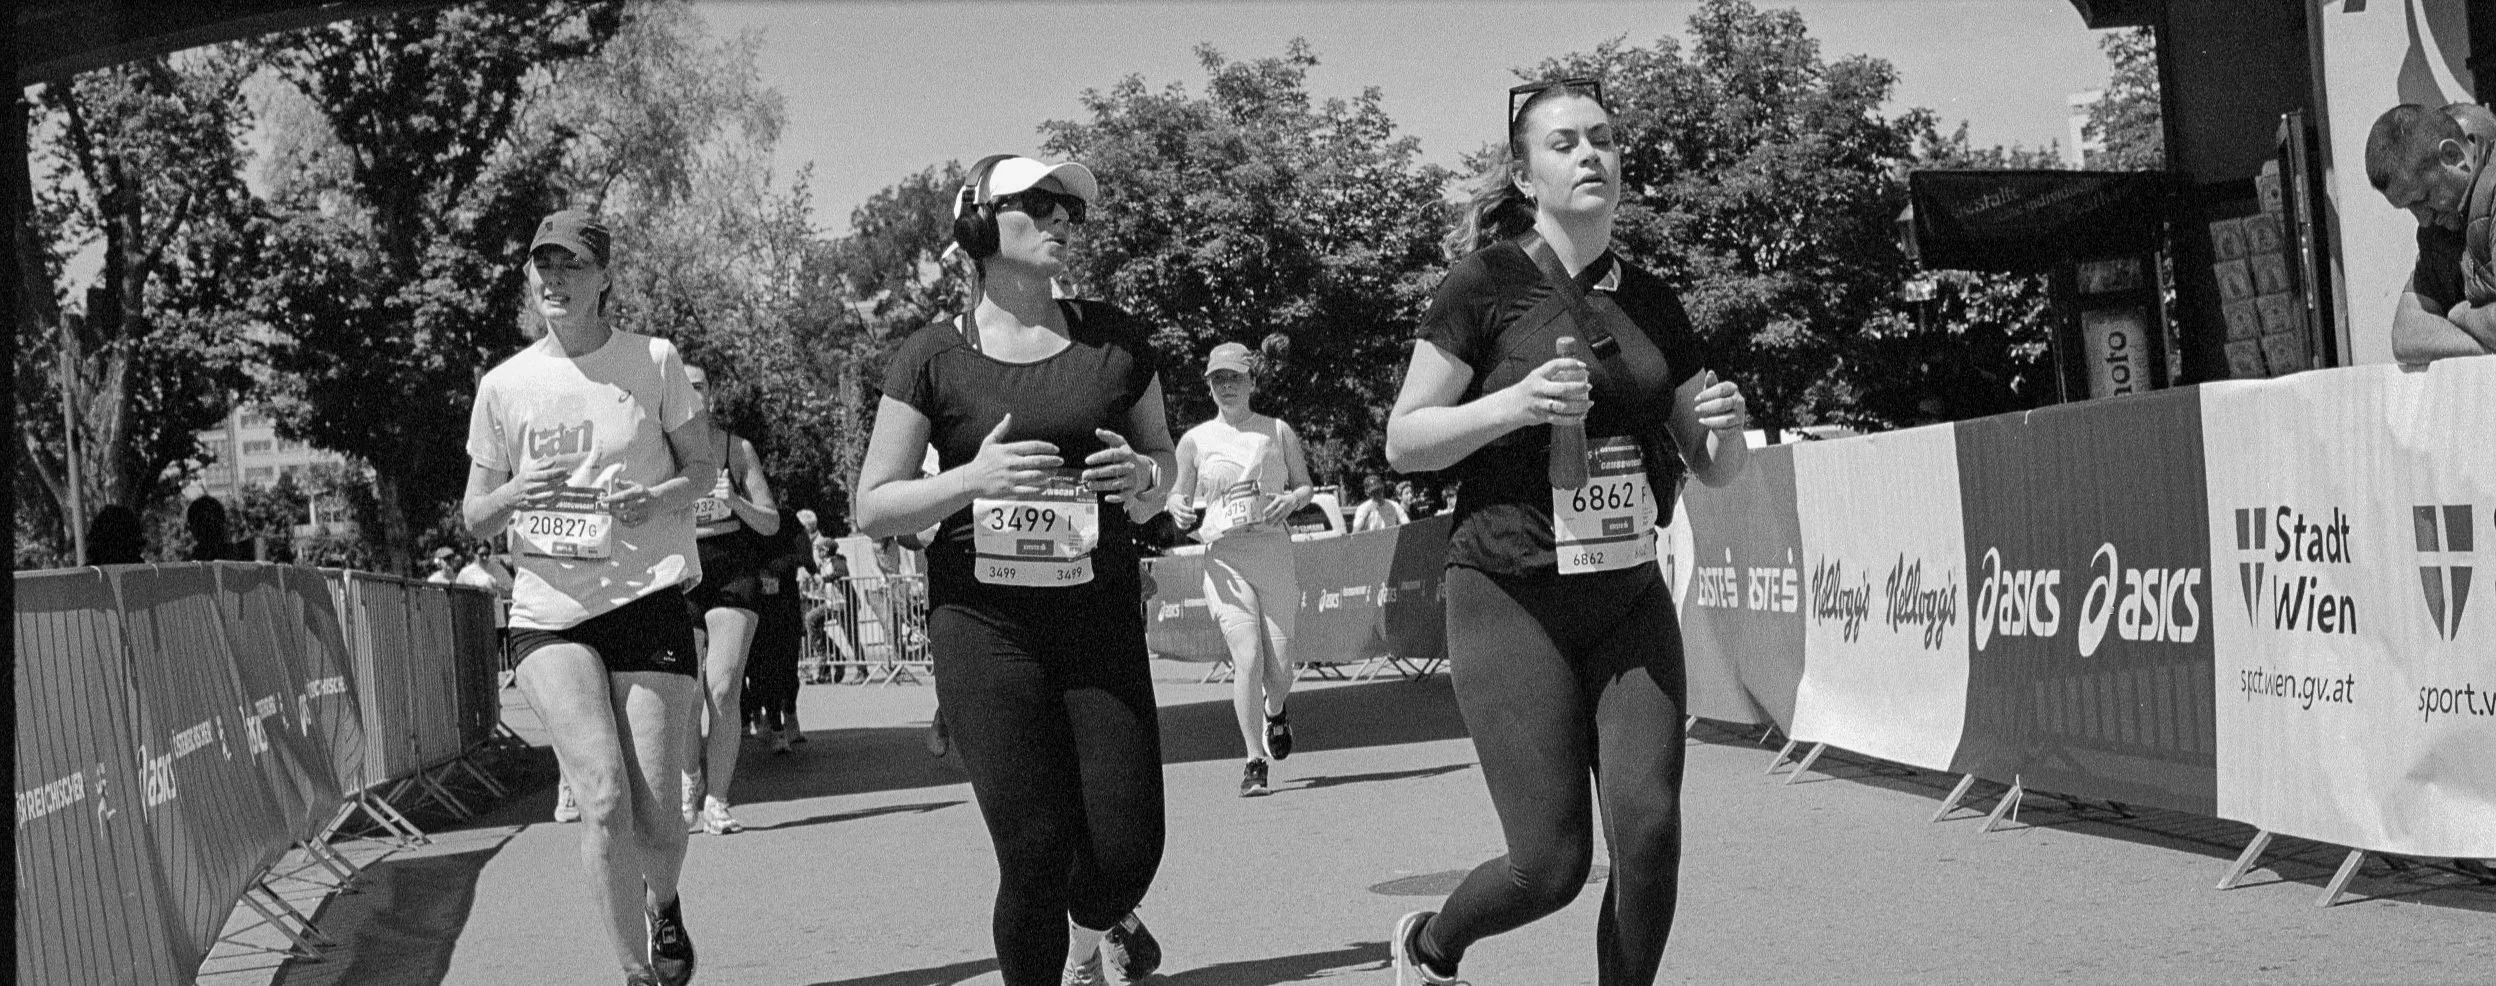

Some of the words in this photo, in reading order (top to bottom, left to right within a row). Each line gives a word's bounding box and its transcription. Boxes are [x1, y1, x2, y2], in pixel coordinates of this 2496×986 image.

[1572, 482, 1634, 512] 6862
[530, 515, 587, 538] 20827
[588, 524, 597, 537] G
[991, 507, 1056, 532] 3499
[2274, 504, 2352, 564] Stadt
[1573, 551, 1604, 566] 6862
[989, 566, 1016, 580] 3499
[1057, 566, 1083, 581] 3499
[1811, 552, 1871, 643] Kellogg's
[1885, 551, 1957, 650] Kellogg's
[2273, 575, 2357, 635] Wien
